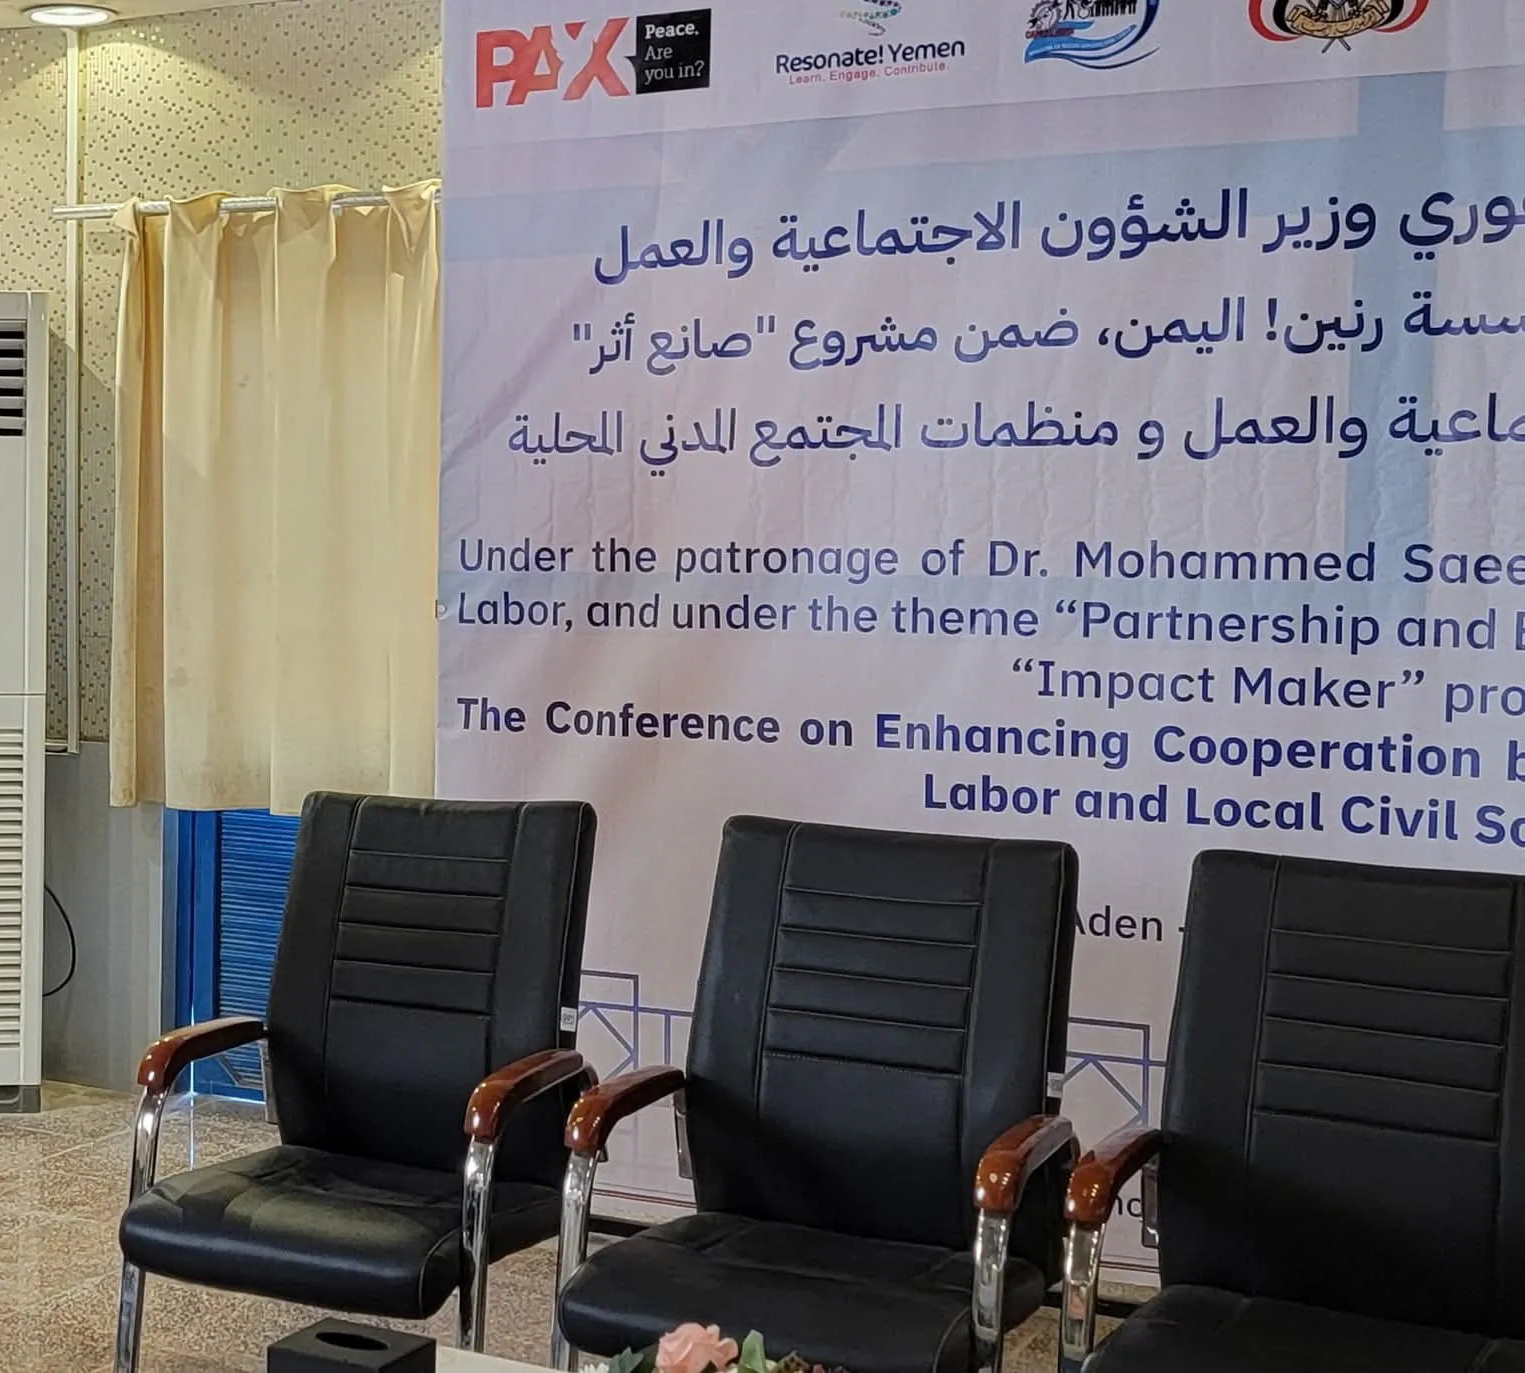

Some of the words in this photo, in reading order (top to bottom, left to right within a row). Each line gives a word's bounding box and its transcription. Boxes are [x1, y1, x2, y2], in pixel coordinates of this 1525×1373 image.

[645, 23, 699, 40] Peace.
[645, 45, 673, 61] Are
[776, 45, 883, 74] Resonate!
[888, 40, 965, 63] Yemen
[476, 17, 630, 108] PAX
[645, 66, 674, 85] you
[678, 61, 705, 78] in?
[789, 73, 825, 85] Learn.
[594, 218, 754, 285] والعمل
[772, 199, 1021, 272] الاجتماعية
[1041, 187, 1248, 261] الشؤون
[1262, 196, 1376, 251] وزير
[573, 311, 636, 374] أثر"
[646, 314, 775, 376] "صانع
[789, 316, 938, 371] مشروع
[953, 307, 1080, 363] ضمن
[1098, 296, 1246, 358] اليمن،
[507, 409, 623, 465] المحلية
[639, 406, 737, 477] المدني
[748, 402, 903, 468] المجتمع
[920, 400, 1119, 449] منظمات
[1136, 417, 1165, 460] و
[1183, 394, 1369, 460] والعمل
[460, 537, 574, 573] Under
[592, 537, 656, 573] the
[675, 541, 899, 584] patronage
[921, 538, 965, 577] of
[989, 540, 1048, 577] Dr.
[1075, 539, 1376, 581] Mohammed
[458, 591, 573, 632] Labor,
[586, 593, 660, 628] and
[673, 594, 796, 630] under
[808, 595, 877, 633] the
[891, 597, 1039, 636] theme
[1055, 599, 1380, 655] “Partnership
[1397, 607, 1496, 650] and
[1012, 658, 1215, 709] “Impact
[1234, 666, 1425, 709] Maker”
[457, 697, 526, 732] The
[546, 701, 780, 743] Conference
[800, 718, 853, 747] on
[876, 713, 1129, 770] Enhancing
[1154, 725, 1480, 778] Cooperation
[924, 774, 1060, 815] Labor
[1075, 785, 1167, 823] and
[1186, 787, 1324, 831] Local
[1341, 795, 1458, 841] Civil
